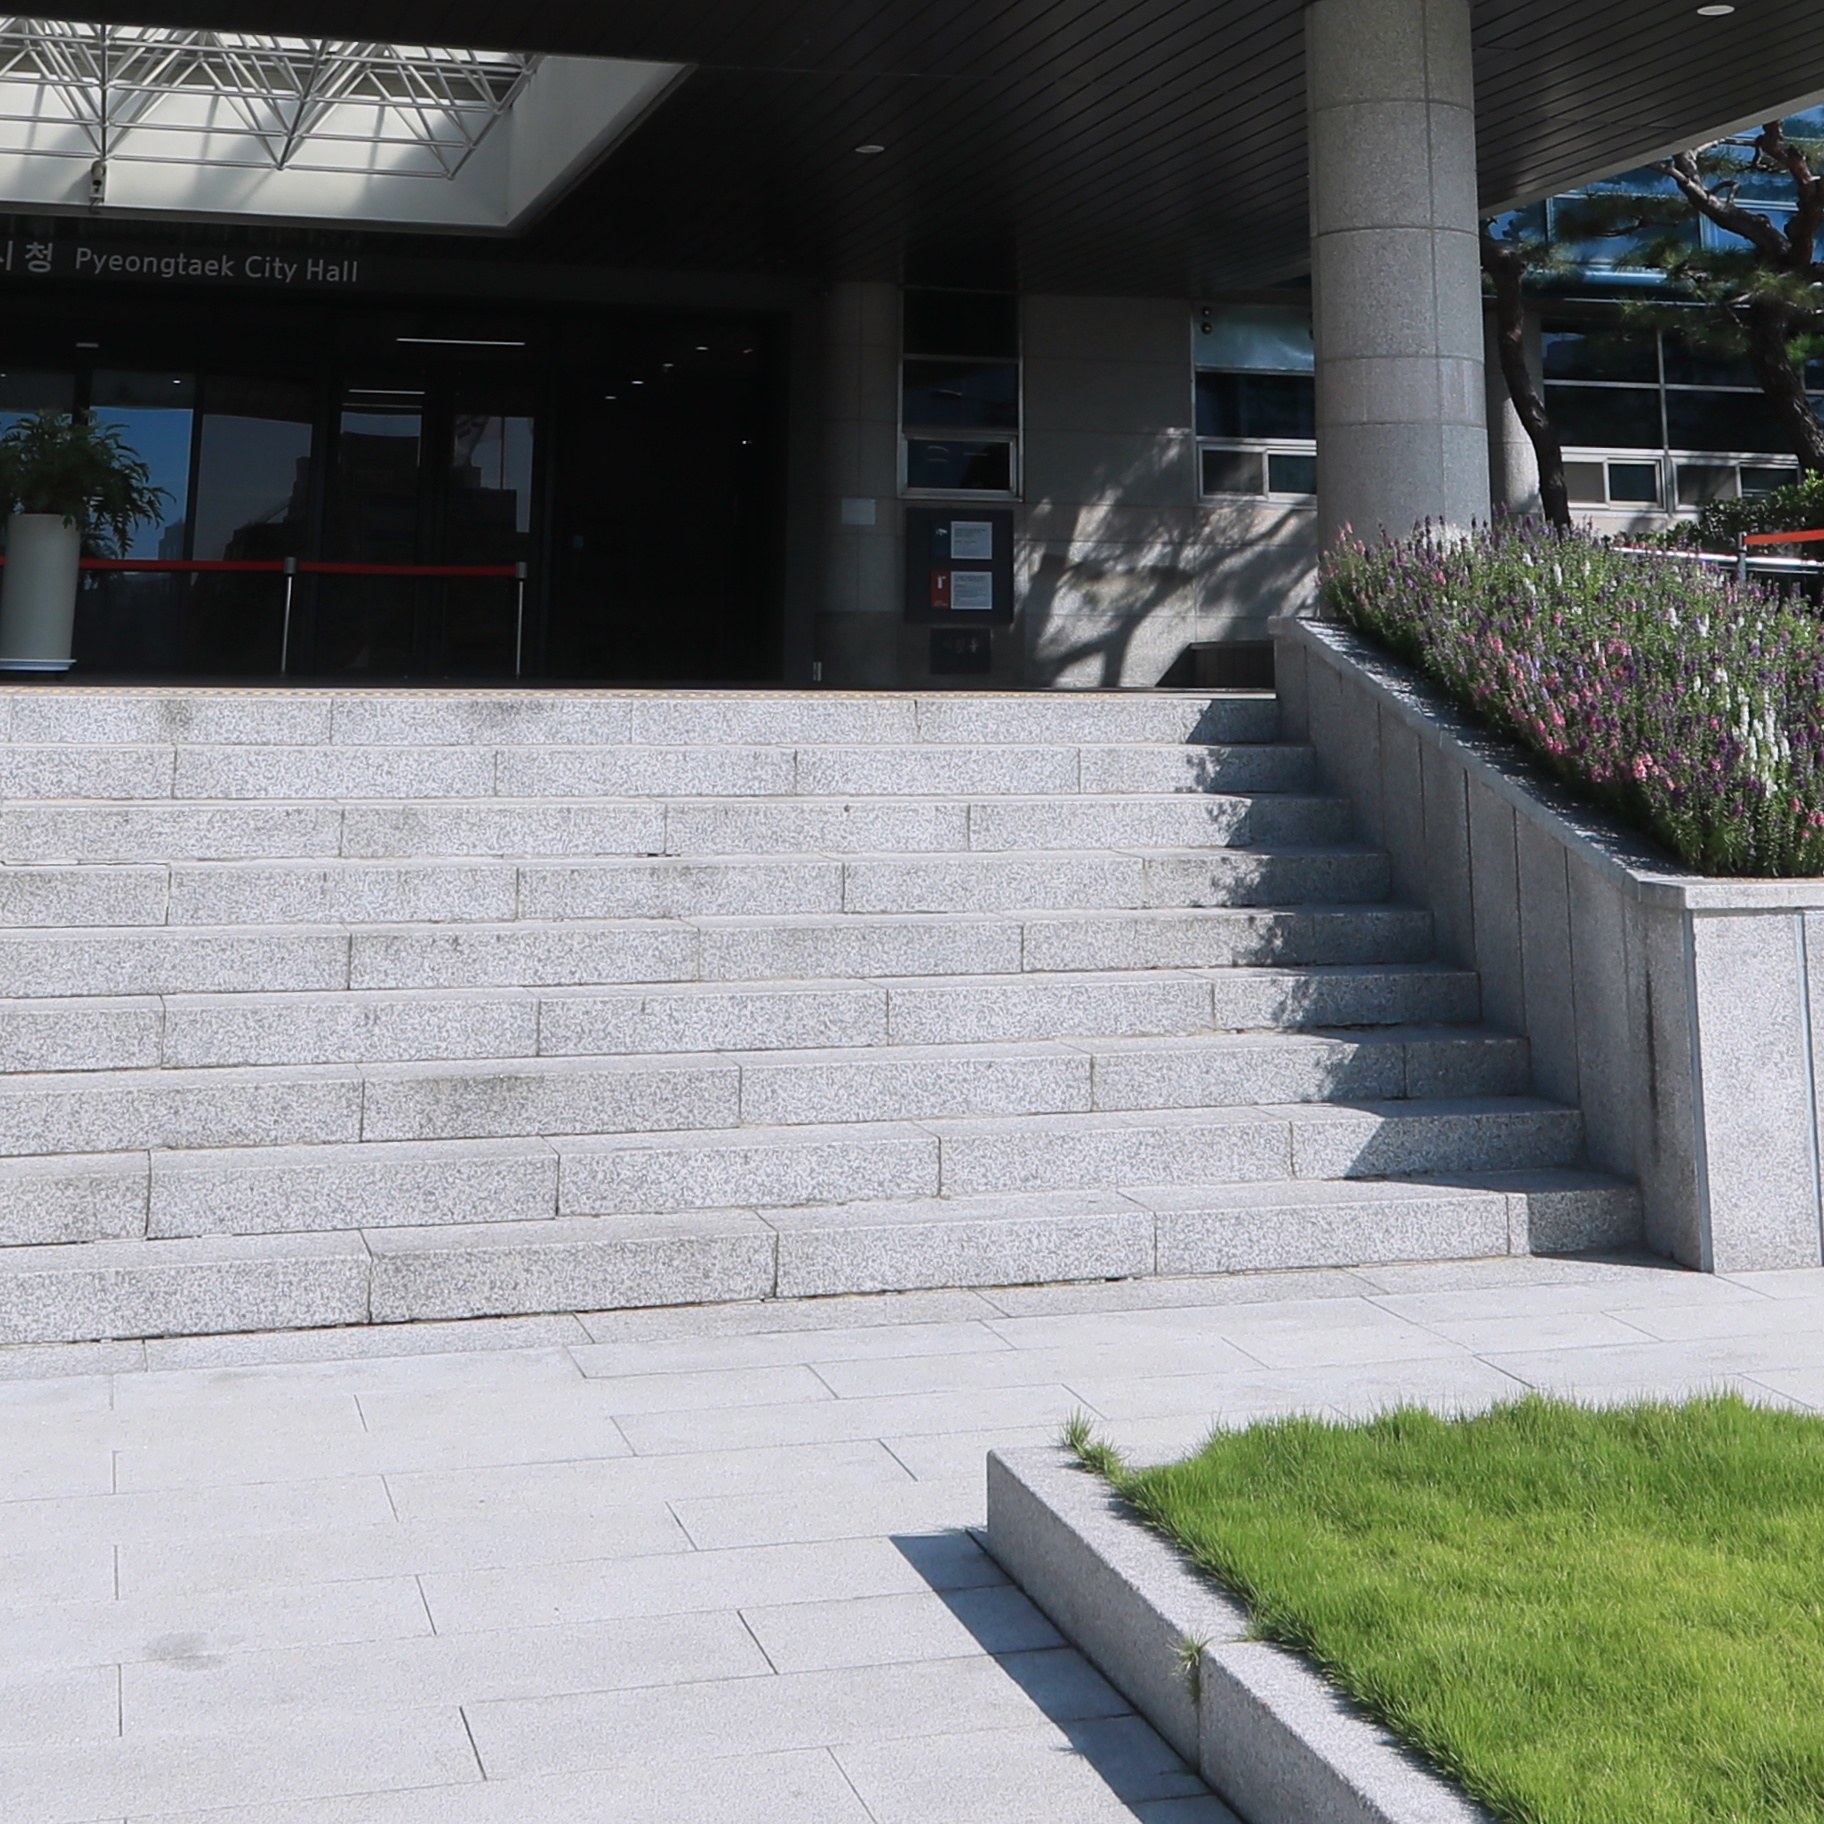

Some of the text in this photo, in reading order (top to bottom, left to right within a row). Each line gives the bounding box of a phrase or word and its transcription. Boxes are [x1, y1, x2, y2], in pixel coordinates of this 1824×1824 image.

[75, 247, 235, 277] Pyeongtaek
[245, 255, 297, 283] City
[306, 258, 358, 283] Hall
